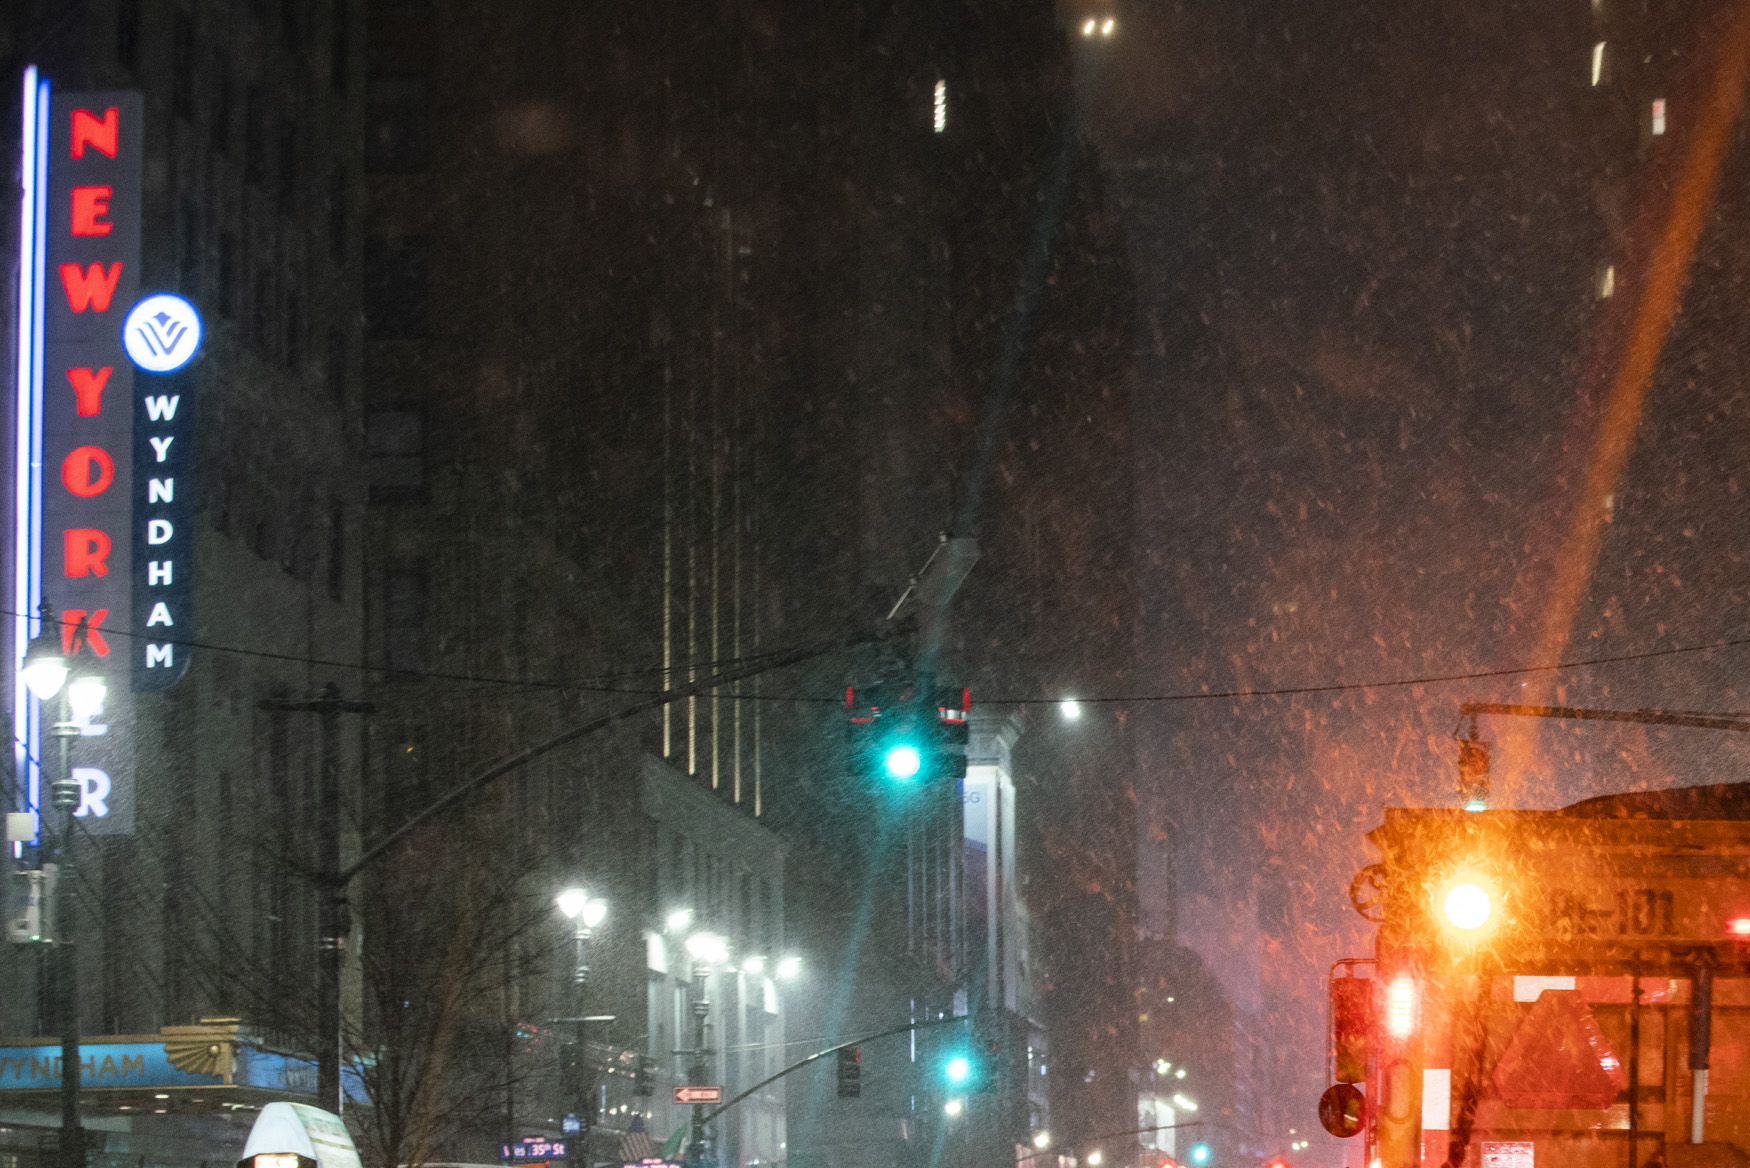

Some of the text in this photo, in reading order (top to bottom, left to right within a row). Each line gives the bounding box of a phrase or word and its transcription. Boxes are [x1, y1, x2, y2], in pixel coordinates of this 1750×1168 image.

[58, 106, 123, 314] NEW
[144, 394, 181, 668] WYNDHAM
[552, 1143, 565, 1155] St
